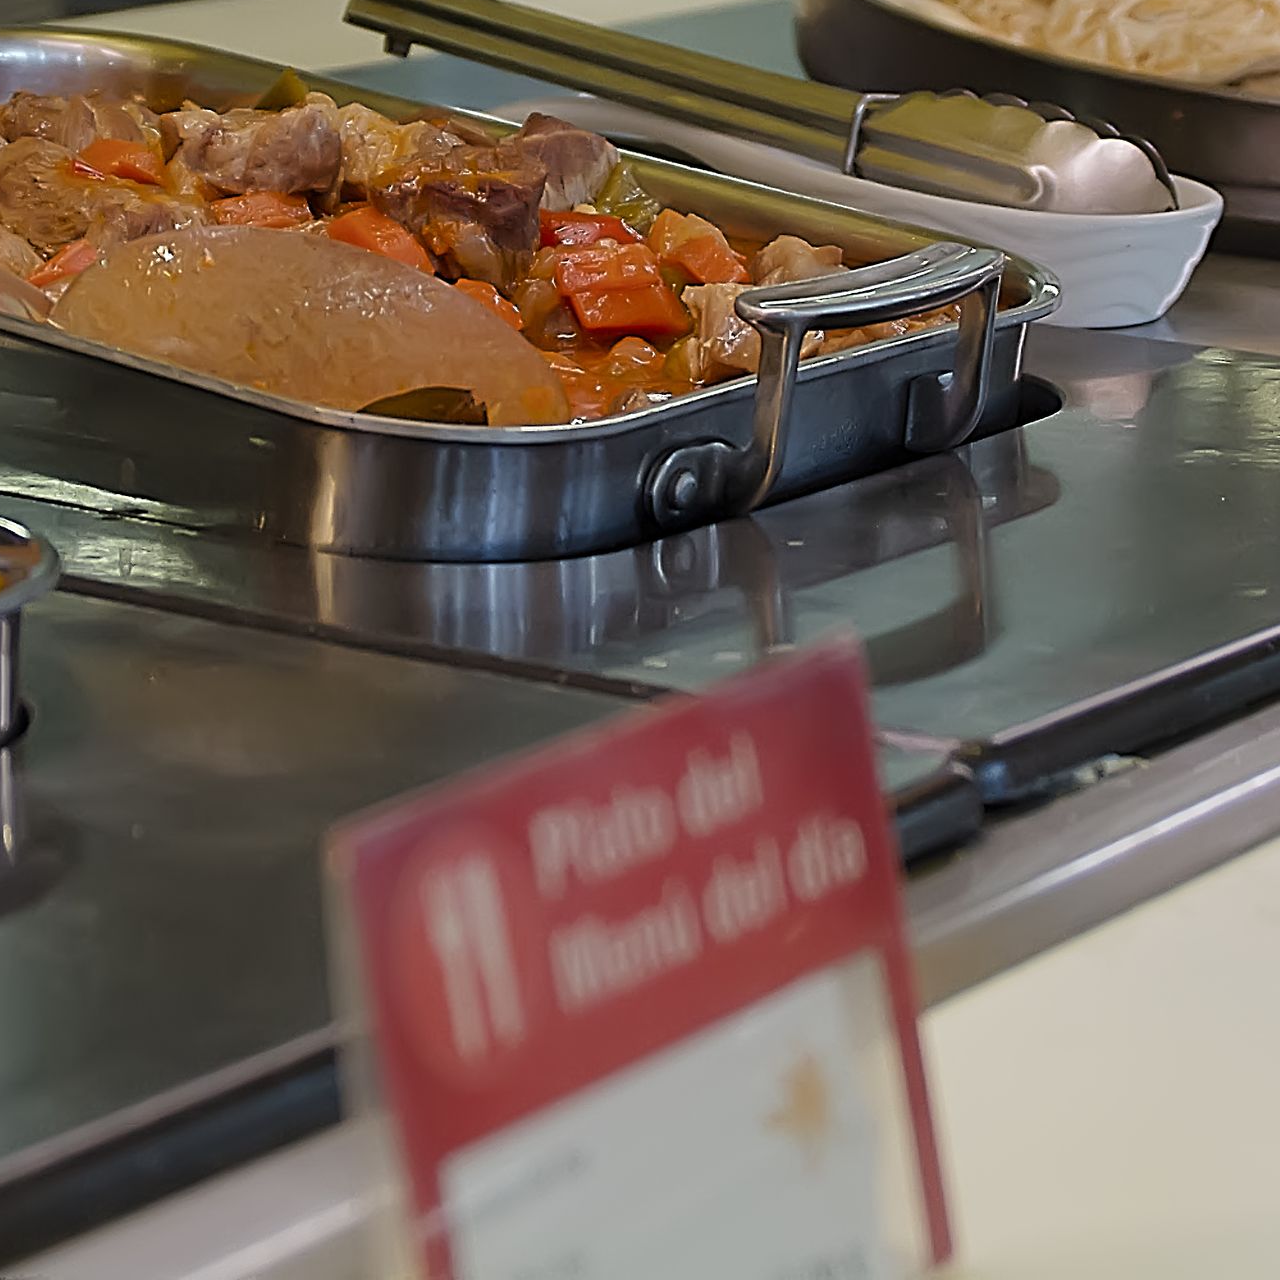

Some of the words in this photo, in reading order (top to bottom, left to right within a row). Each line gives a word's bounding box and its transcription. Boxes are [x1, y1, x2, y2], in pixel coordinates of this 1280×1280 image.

[529, 788, 676, 899] Plato
[677, 730, 763, 838] del
[702, 837, 786, 944] del
